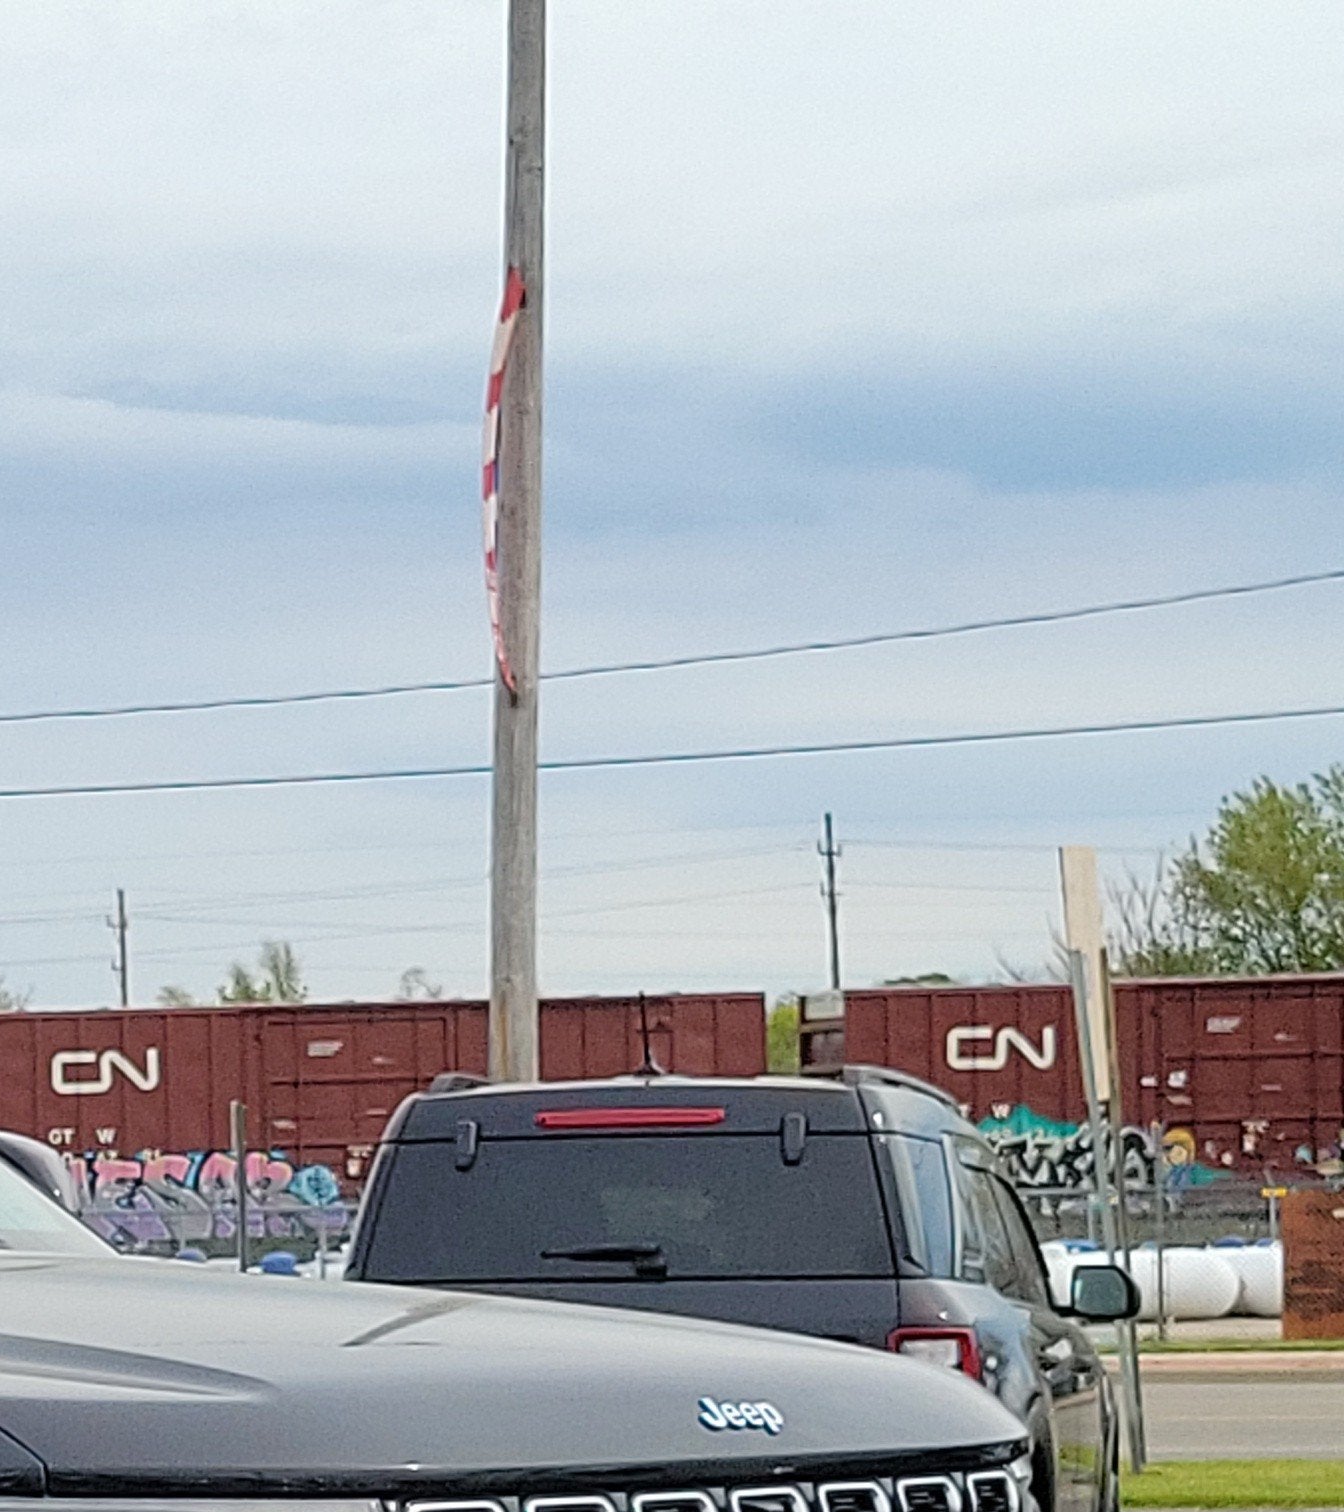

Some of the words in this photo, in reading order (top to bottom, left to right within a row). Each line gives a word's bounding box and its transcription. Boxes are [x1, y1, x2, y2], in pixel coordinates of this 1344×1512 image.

[51, 1047, 160, 1095] CN
[946, 1025, 1055, 1071] CN
[698, 1397, 784, 1436] Jeep
